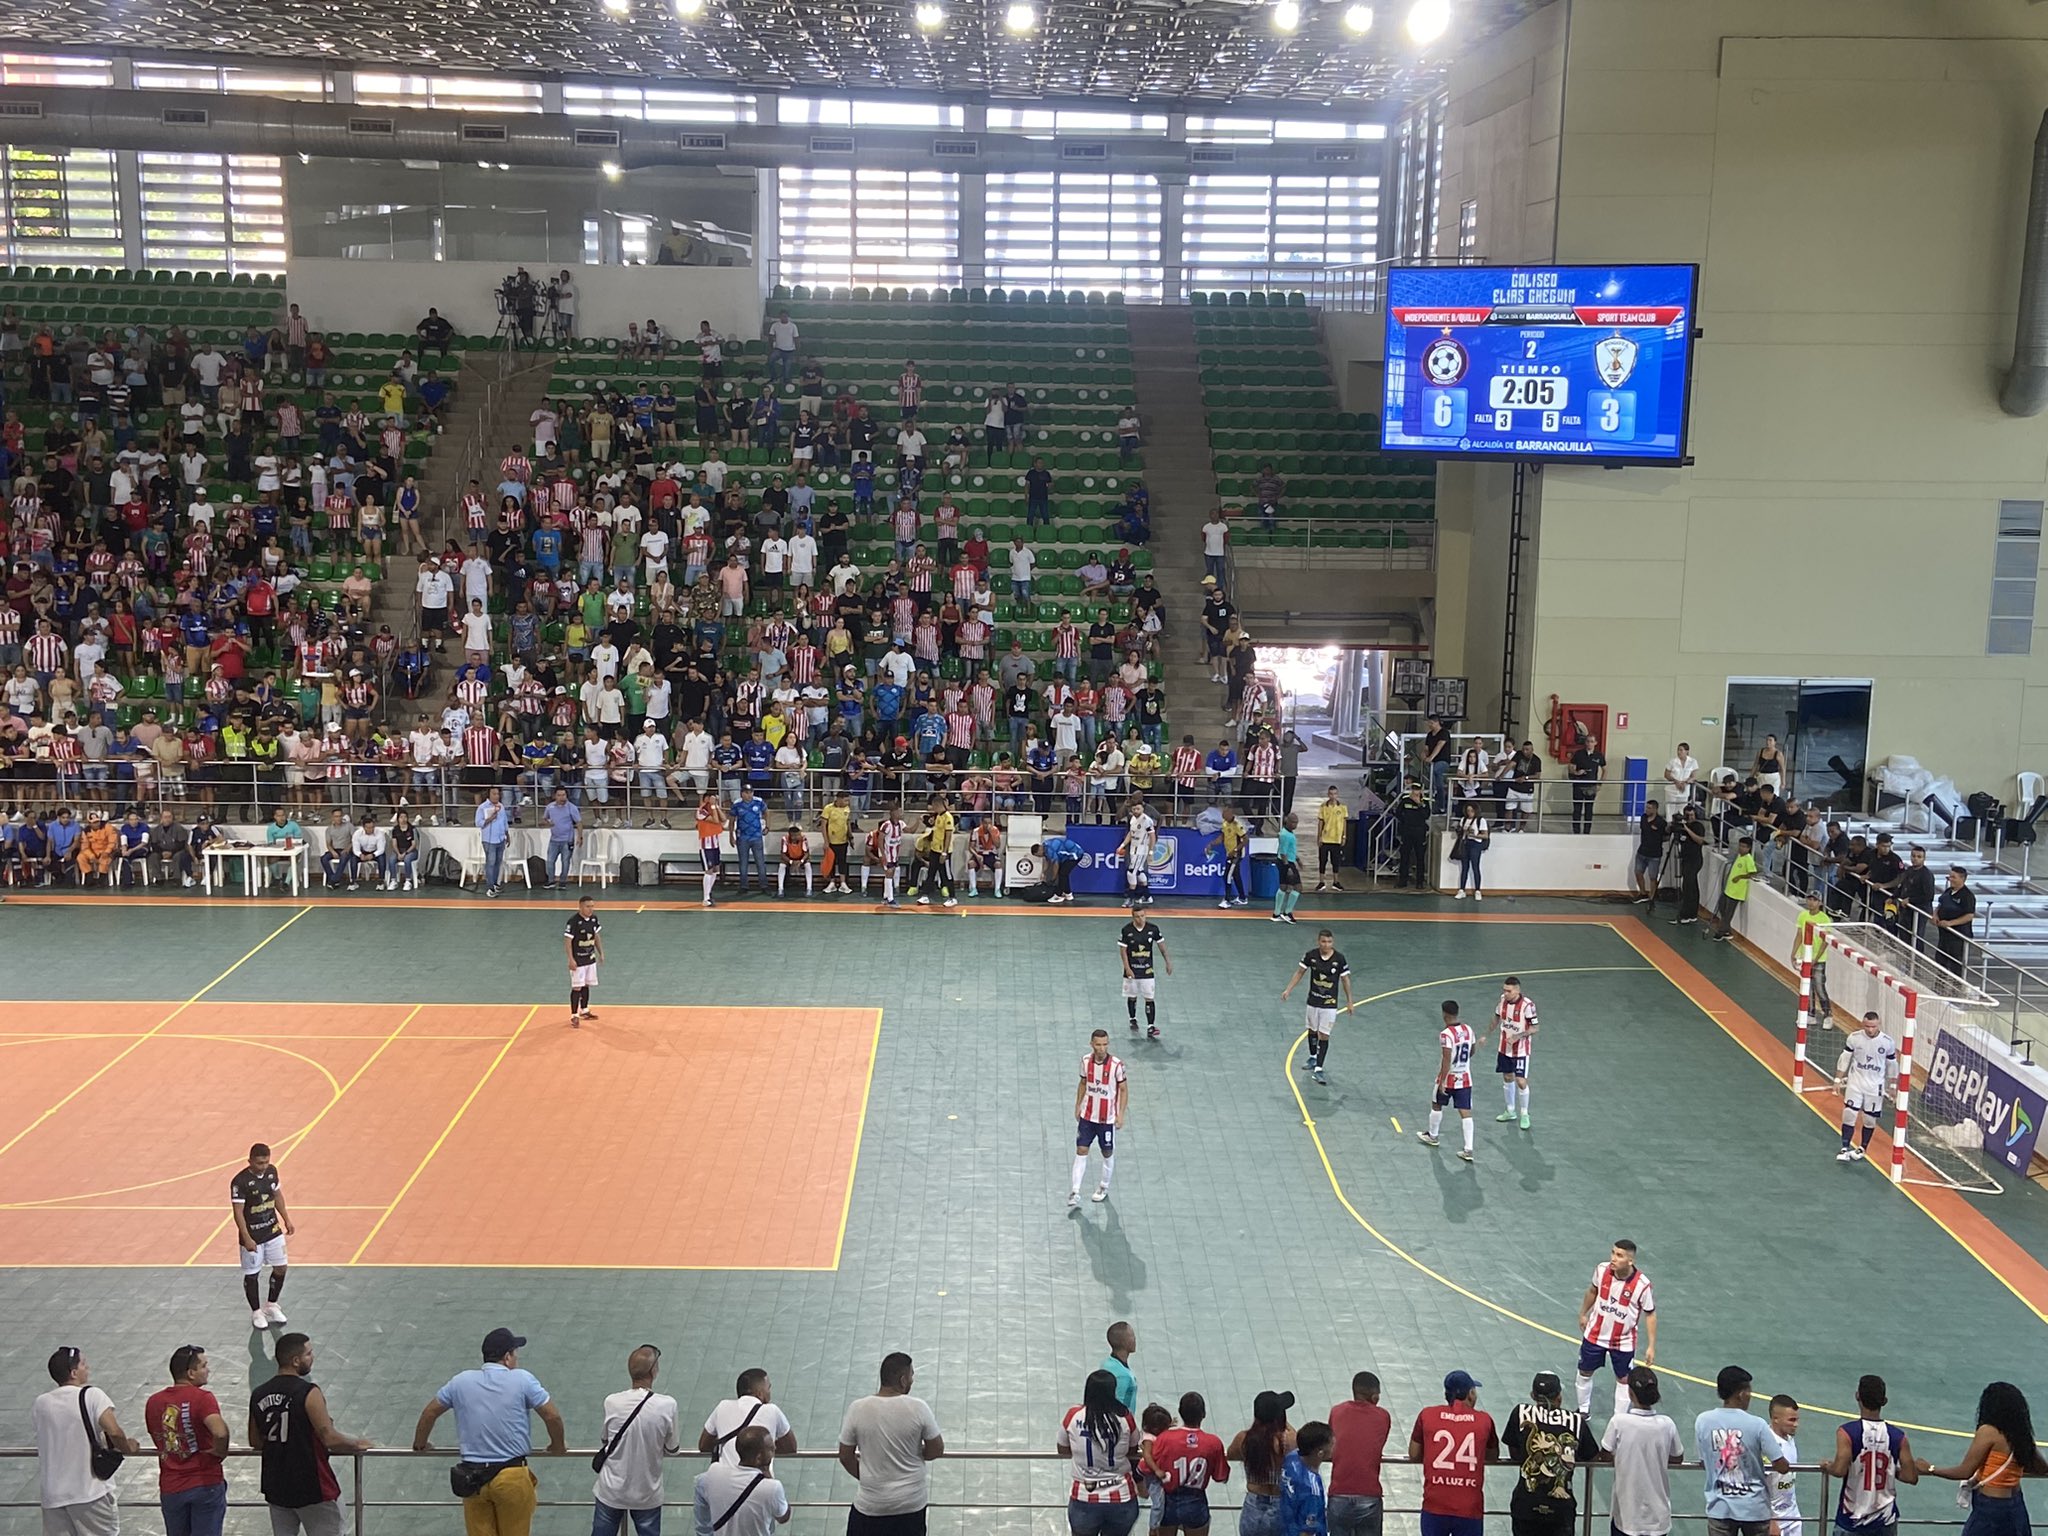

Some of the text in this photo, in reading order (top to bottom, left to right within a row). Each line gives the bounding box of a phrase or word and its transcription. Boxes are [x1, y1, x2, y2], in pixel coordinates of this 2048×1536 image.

[1492, 289, 1525, 304] ELIAS
[1404, 313, 1451, 322] INDEPENDIENTE
[1597, 313, 1656, 323] SPORT TEAM CLUB
[1520, 330, 1545, 339] PERIODO
[1526, 341, 1537, 359] 2
[1501, 365, 1561, 375] TIEMPO
[1502, 378, 1555, 405] 2:05
[1434, 395, 1453, 428] 6
[1600, 398, 1620, 432] 3
[1474, 413, 1508, 428] FALTA 3
[1546, 414, 1581, 428] 5 FALTA
[1472, 439, 1593, 452] ALCALDÍA DE BARRANQUILLA
[1095, 852, 1125, 869] FCF
[1452, 1043, 1469, 1064] 16
[1930, 1047, 2010, 1135] BetPlay
[266, 1411, 289, 1443] 21
[1519, 1403, 1581, 1440] KNIGHT
[1432, 1429, 1478, 1472] 24
[1432, 1476, 1477, 1487] LA LUZ FC
